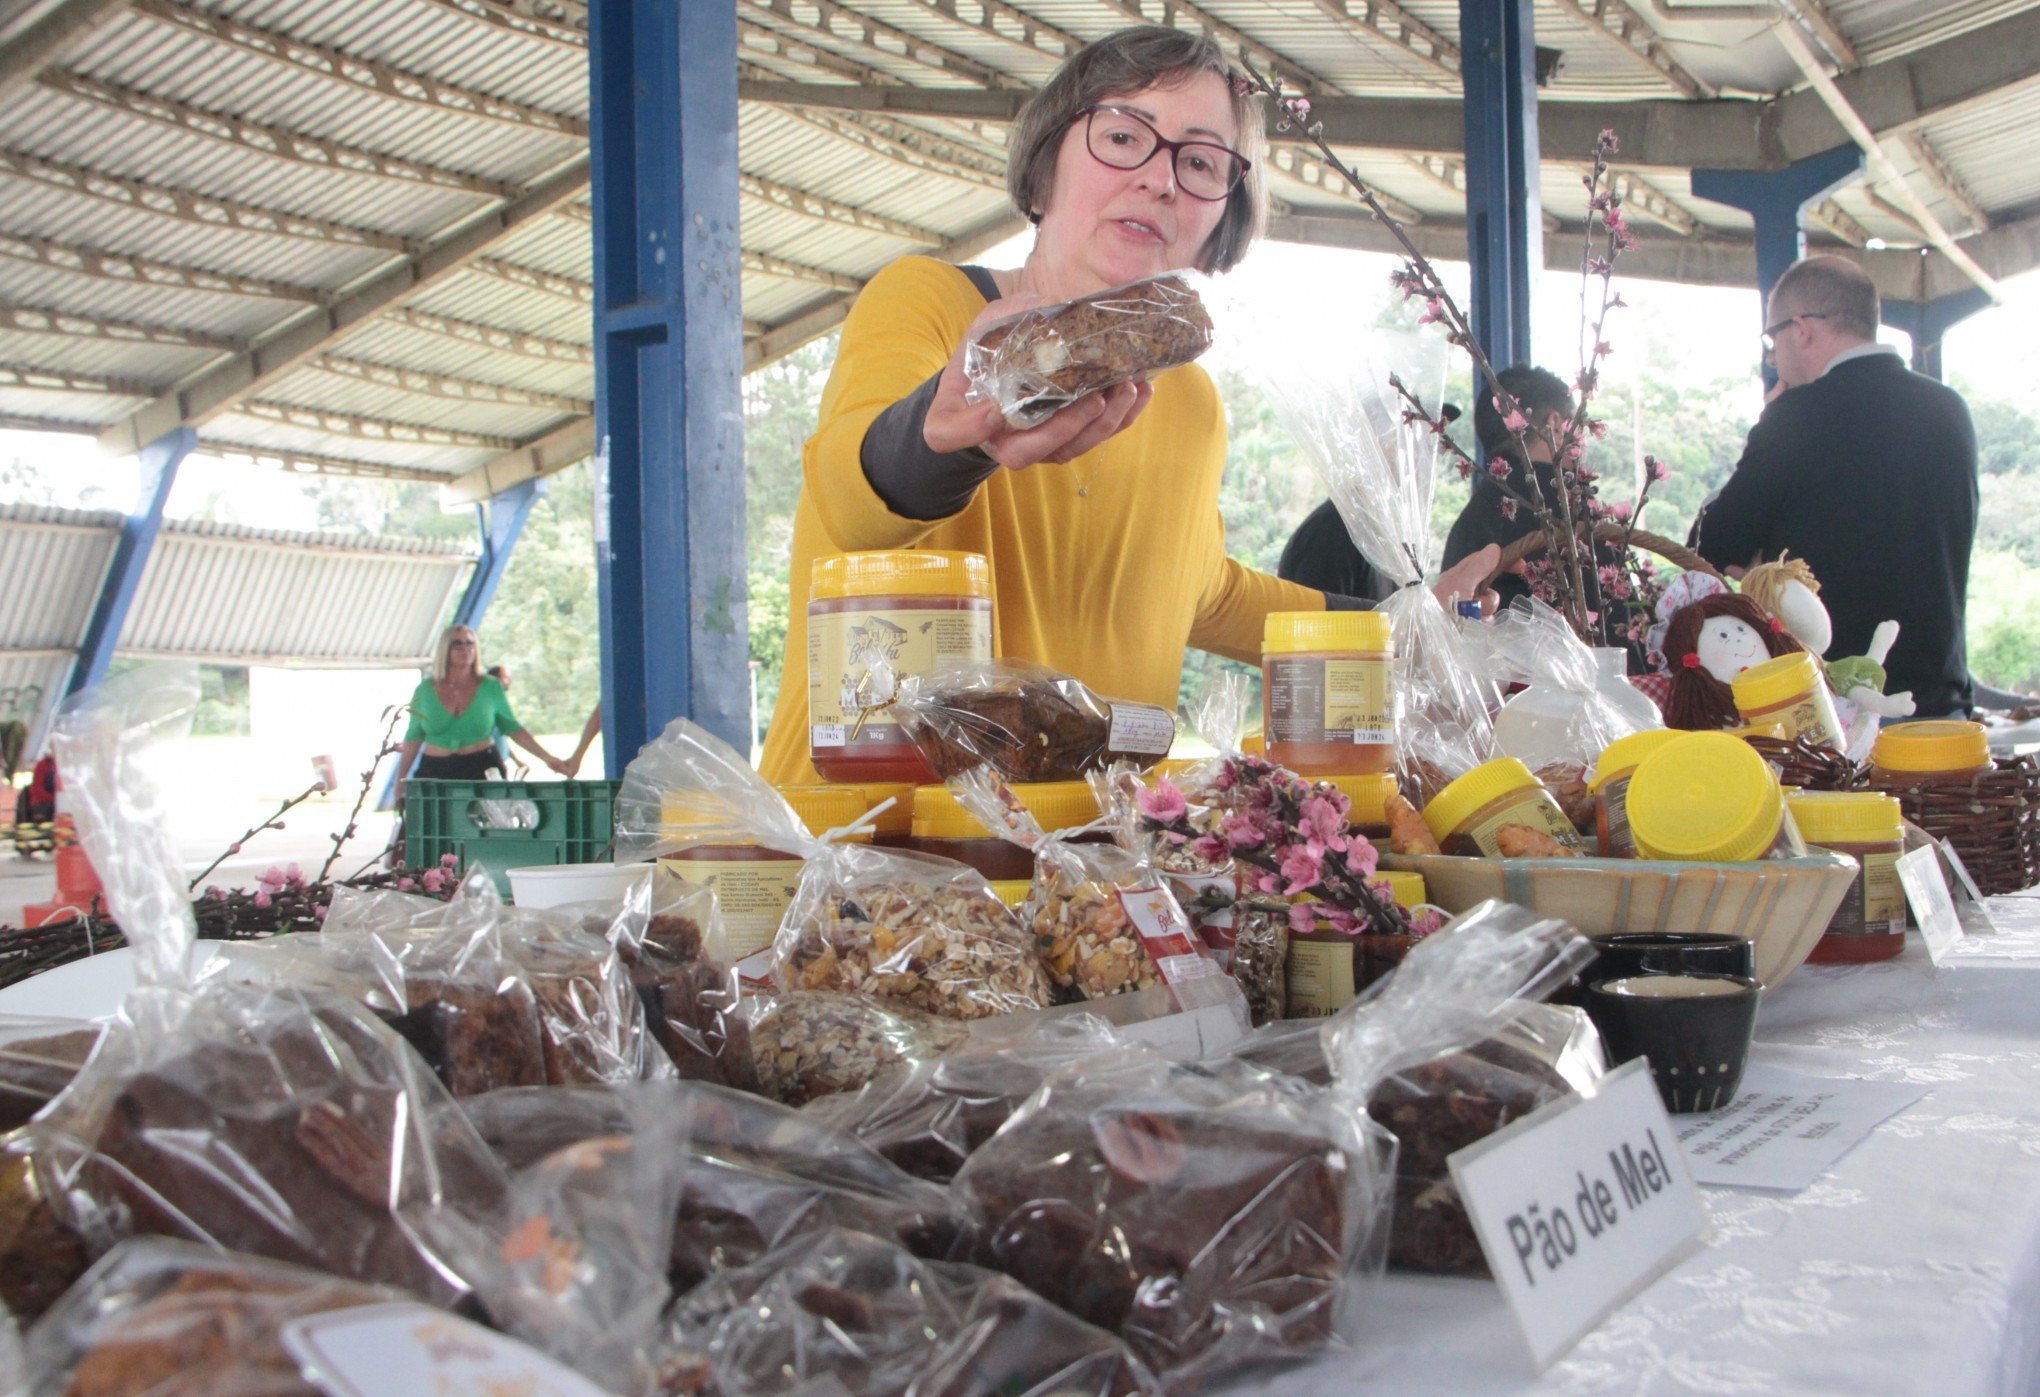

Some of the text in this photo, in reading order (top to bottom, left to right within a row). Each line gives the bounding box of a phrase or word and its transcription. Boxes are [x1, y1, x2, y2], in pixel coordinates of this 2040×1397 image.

[868, 731, 885, 741] 1Kg
[1505, 1204, 1578, 1287] Pão
[1575, 1170, 1617, 1239] de
[1609, 1127, 1673, 1210] Mel
